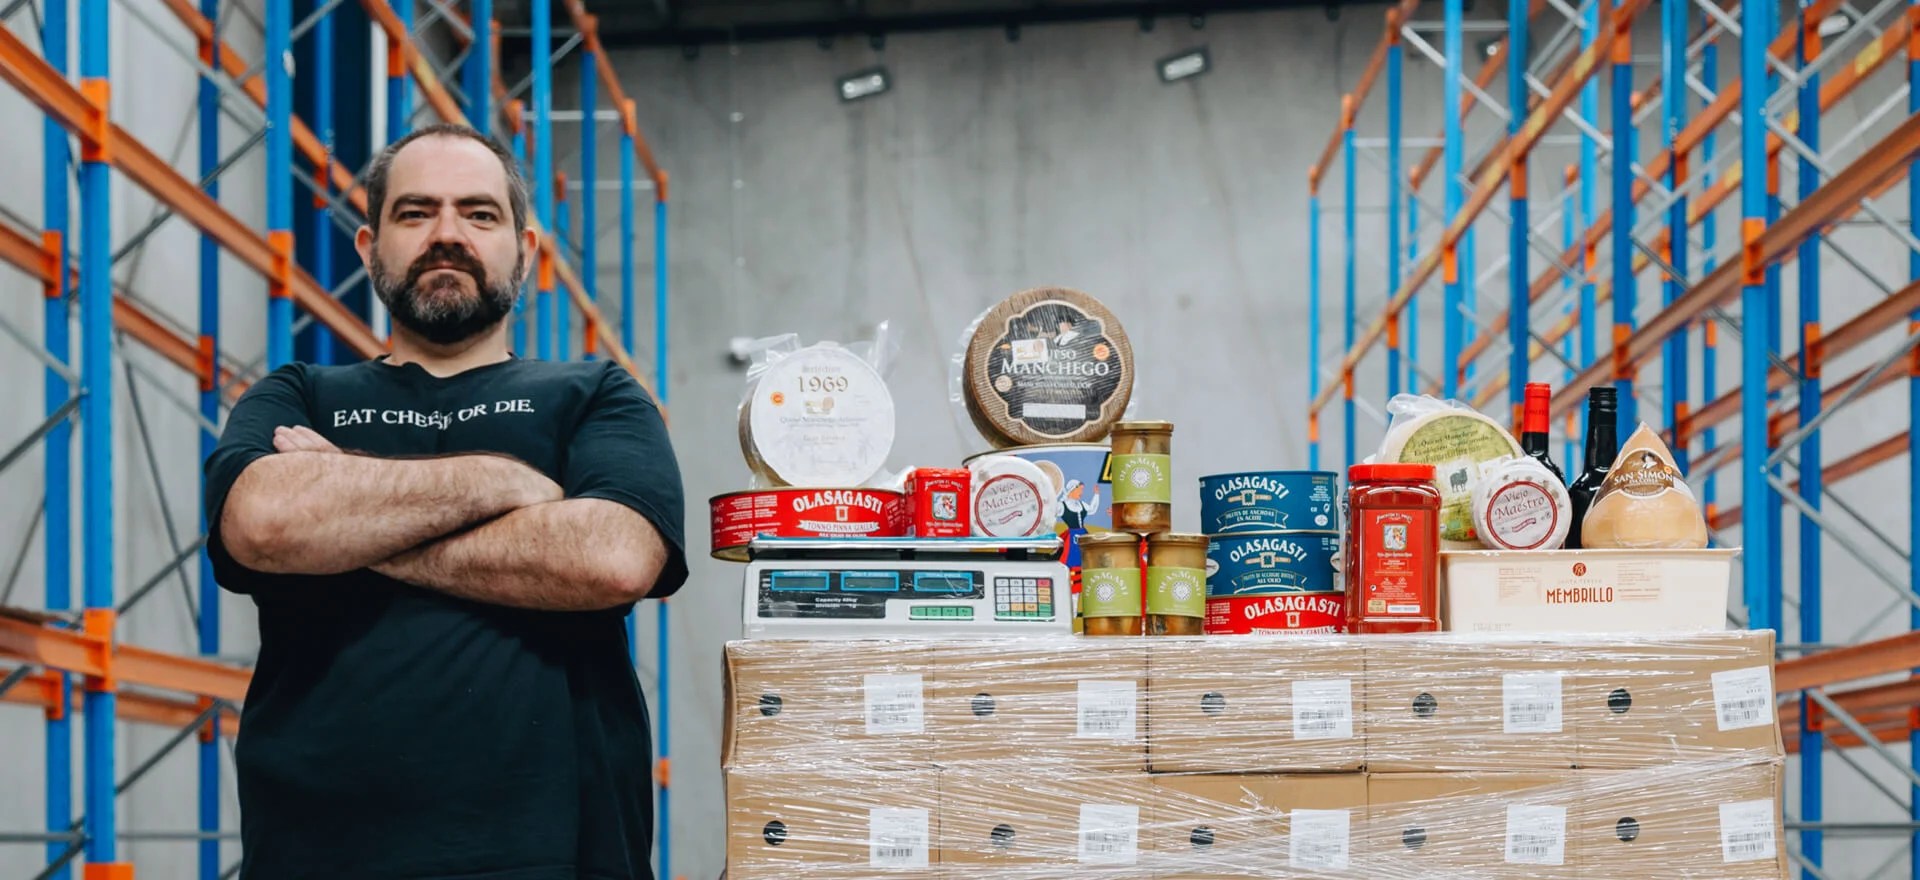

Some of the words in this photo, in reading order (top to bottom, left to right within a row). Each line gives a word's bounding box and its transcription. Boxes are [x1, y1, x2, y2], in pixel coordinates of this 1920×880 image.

[1001, 358, 1109, 376] MANCHEGO
[797, 376, 848, 392] 1969
[333, 409, 376, 427] EAT
[457, 404, 487, 422] OR
[494, 399, 535, 413] DIE.
[1614, 471, 1634, 485] SAN
[991, 482, 1015, 494] Viejo
[1215, 476, 1290, 501] OLASAGASTI
[1503, 489, 1529, 503] Viejo
[792, 490, 883, 514] OLASAGASTI
[982, 488, 1031, 512] Maestro
[1495, 496, 1545, 517] Maestro
[807, 522, 832, 531] TONNO
[1230, 538, 1308, 562] OLASAGASTI
[1546, 586, 1613, 604] MEMBRILLO
[1244, 596, 1340, 619] OLASAGASTI
